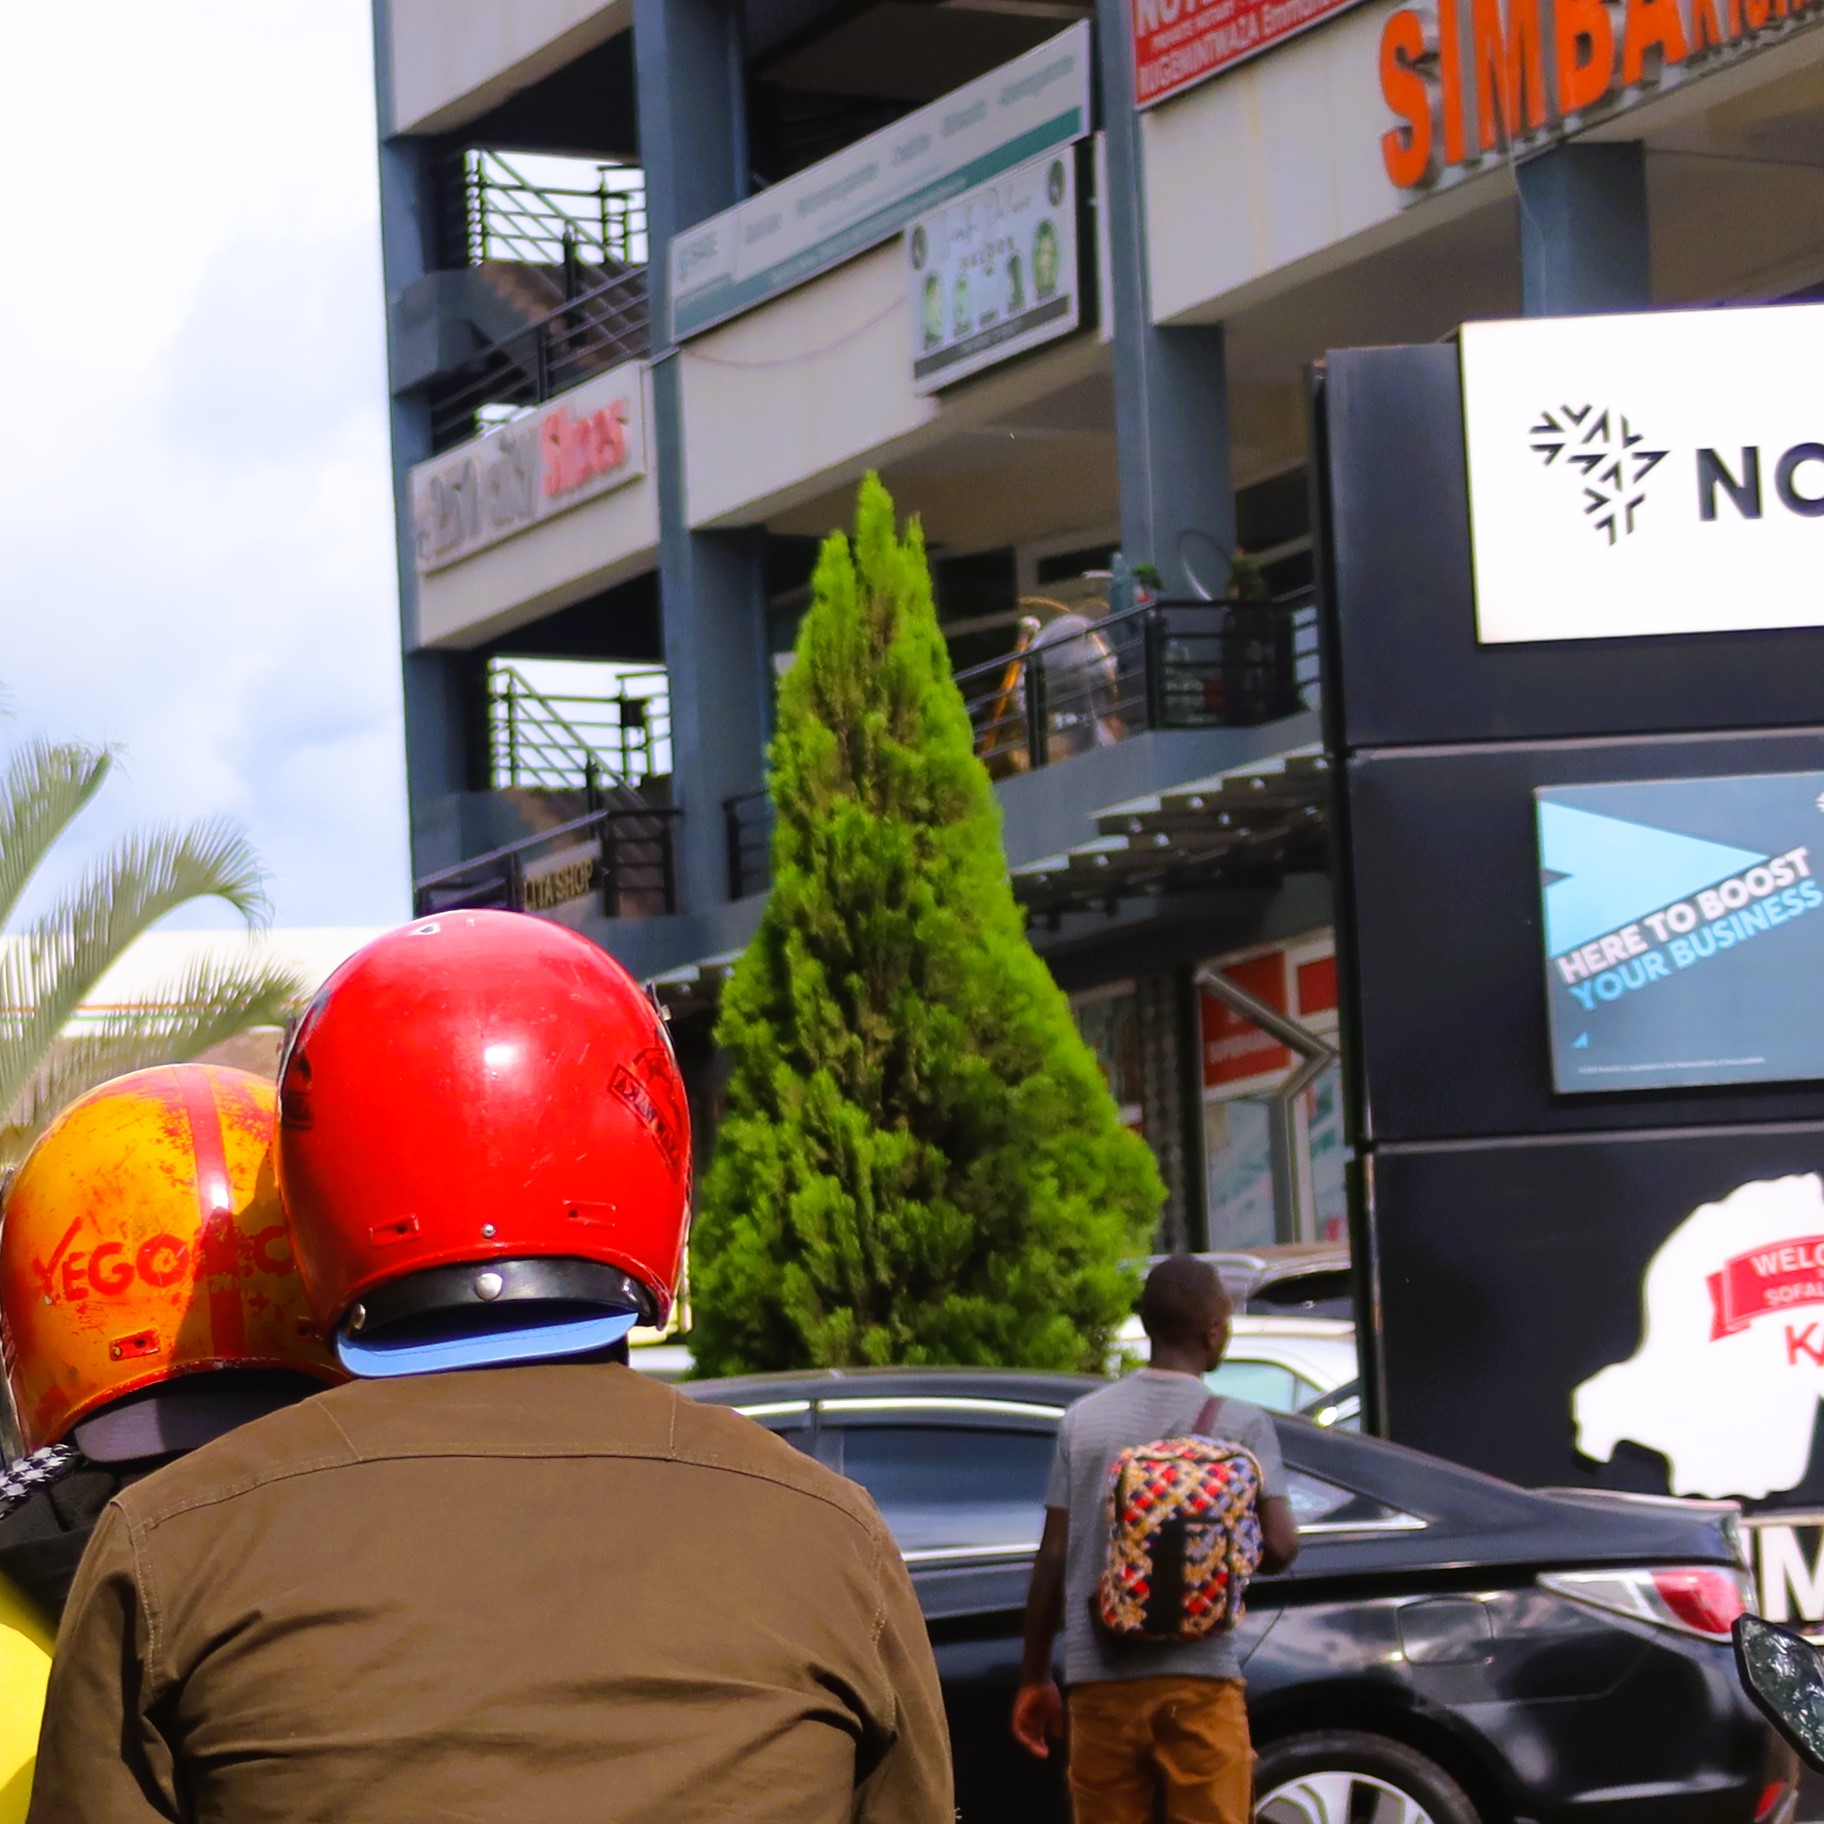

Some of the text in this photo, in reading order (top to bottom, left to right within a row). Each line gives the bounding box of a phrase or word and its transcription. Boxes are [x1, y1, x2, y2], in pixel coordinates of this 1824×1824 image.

[1557, 846, 1811, 984] HERE TO BOOST
[1568, 878, 1824, 1012] YOUR BUSINESS
